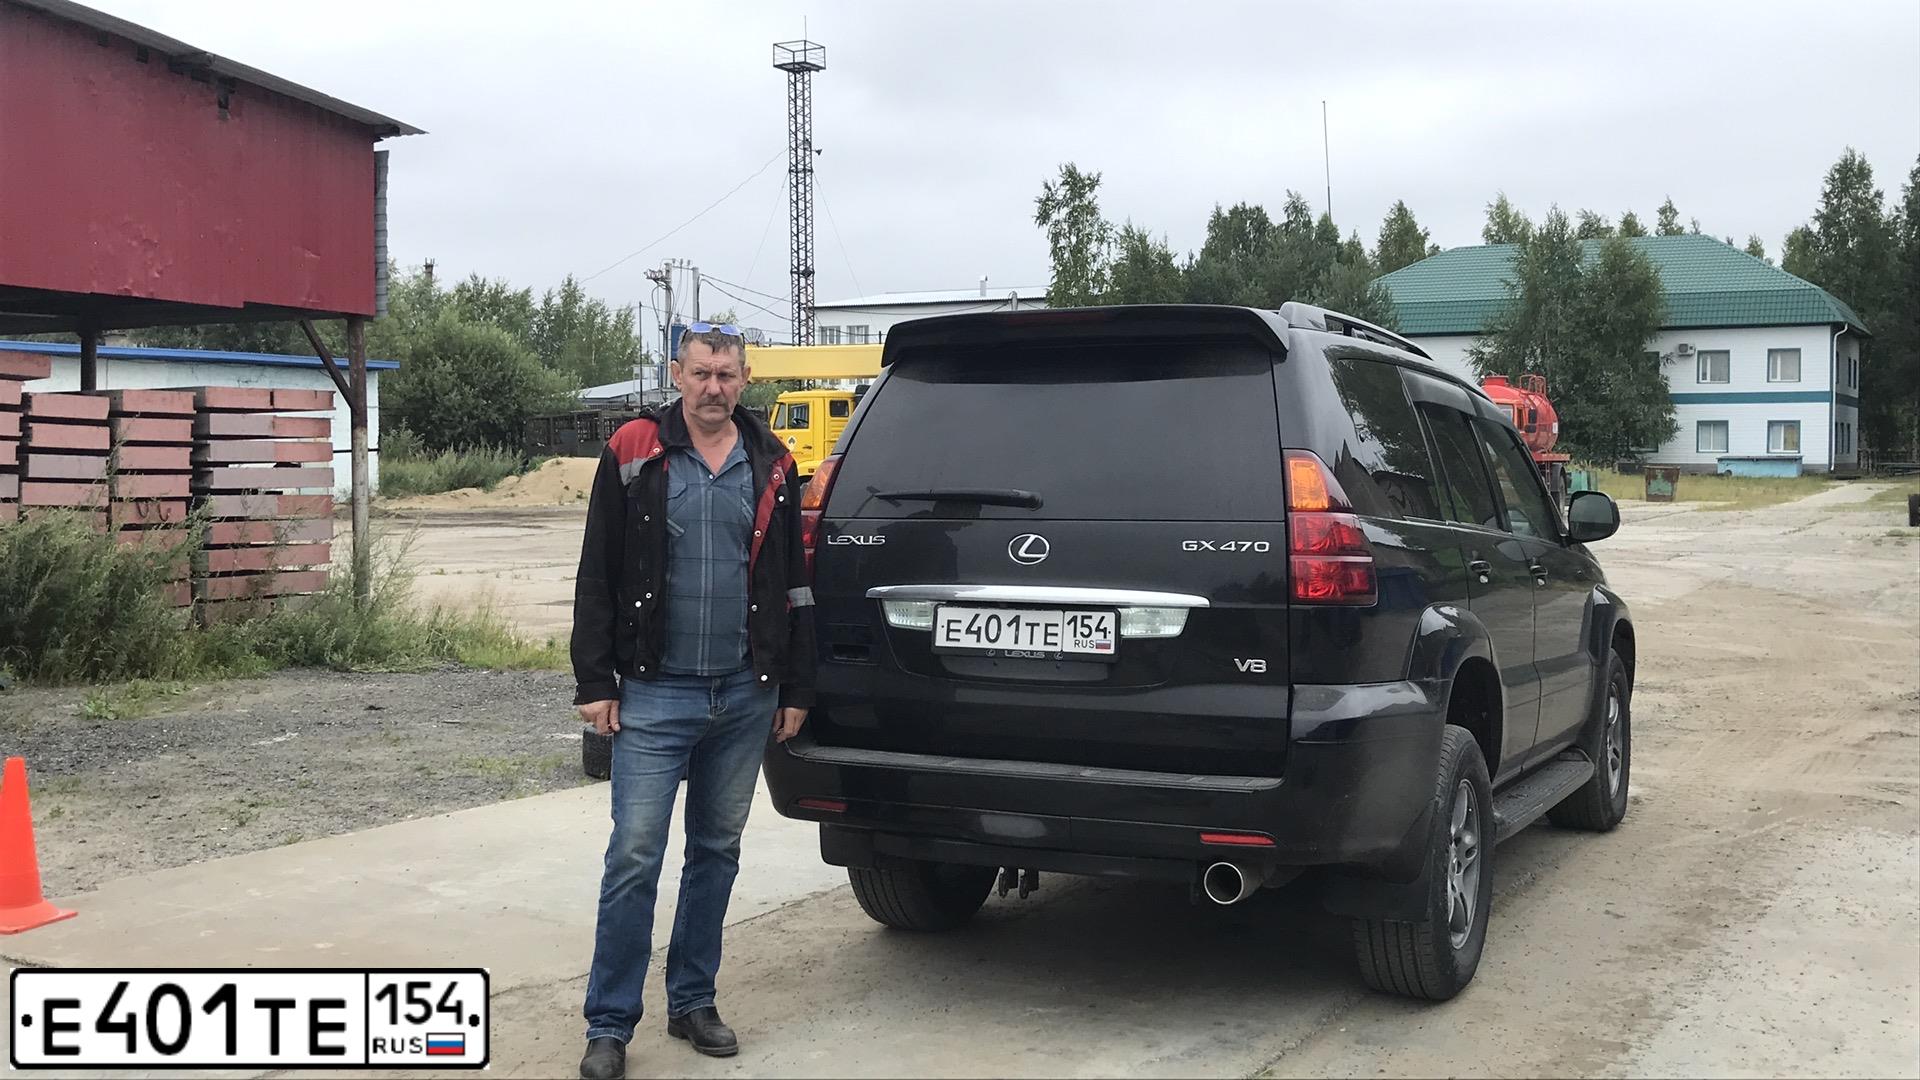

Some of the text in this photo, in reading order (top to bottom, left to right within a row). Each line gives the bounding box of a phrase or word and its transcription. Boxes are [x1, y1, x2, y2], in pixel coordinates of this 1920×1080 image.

[827, 535, 886, 546] LEXUS
[1182, 540, 1271, 553] GX 470
[945, 613, 1109, 647] E401TE 154
[1073, 638, 1096, 649] RUS
[1004, 649, 1046, 659] LEXUS
[1233, 657, 1268, 674] V8
